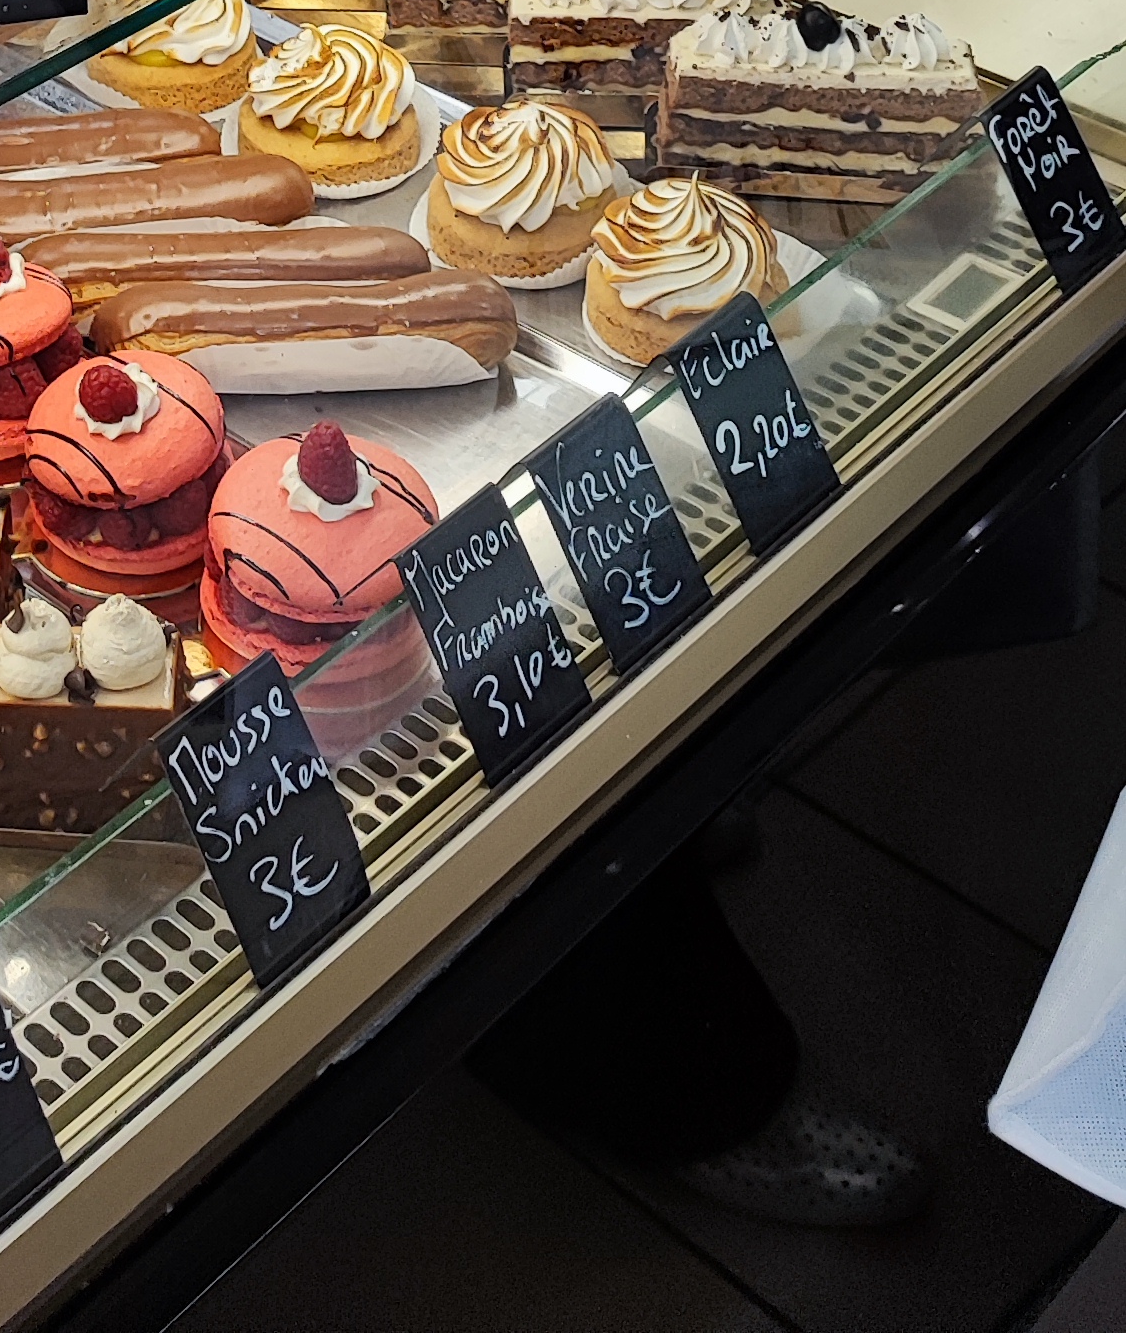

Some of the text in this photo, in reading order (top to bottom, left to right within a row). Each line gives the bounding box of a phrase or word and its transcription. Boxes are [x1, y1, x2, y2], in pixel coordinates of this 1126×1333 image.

[1050, 191, 1104, 252] 3€
[604, 550, 681, 628] 3€
[473, 623, 572, 737] 3,10€
[169, 686, 291, 805] Mousse
[250, 835, 339, 931] 3€
